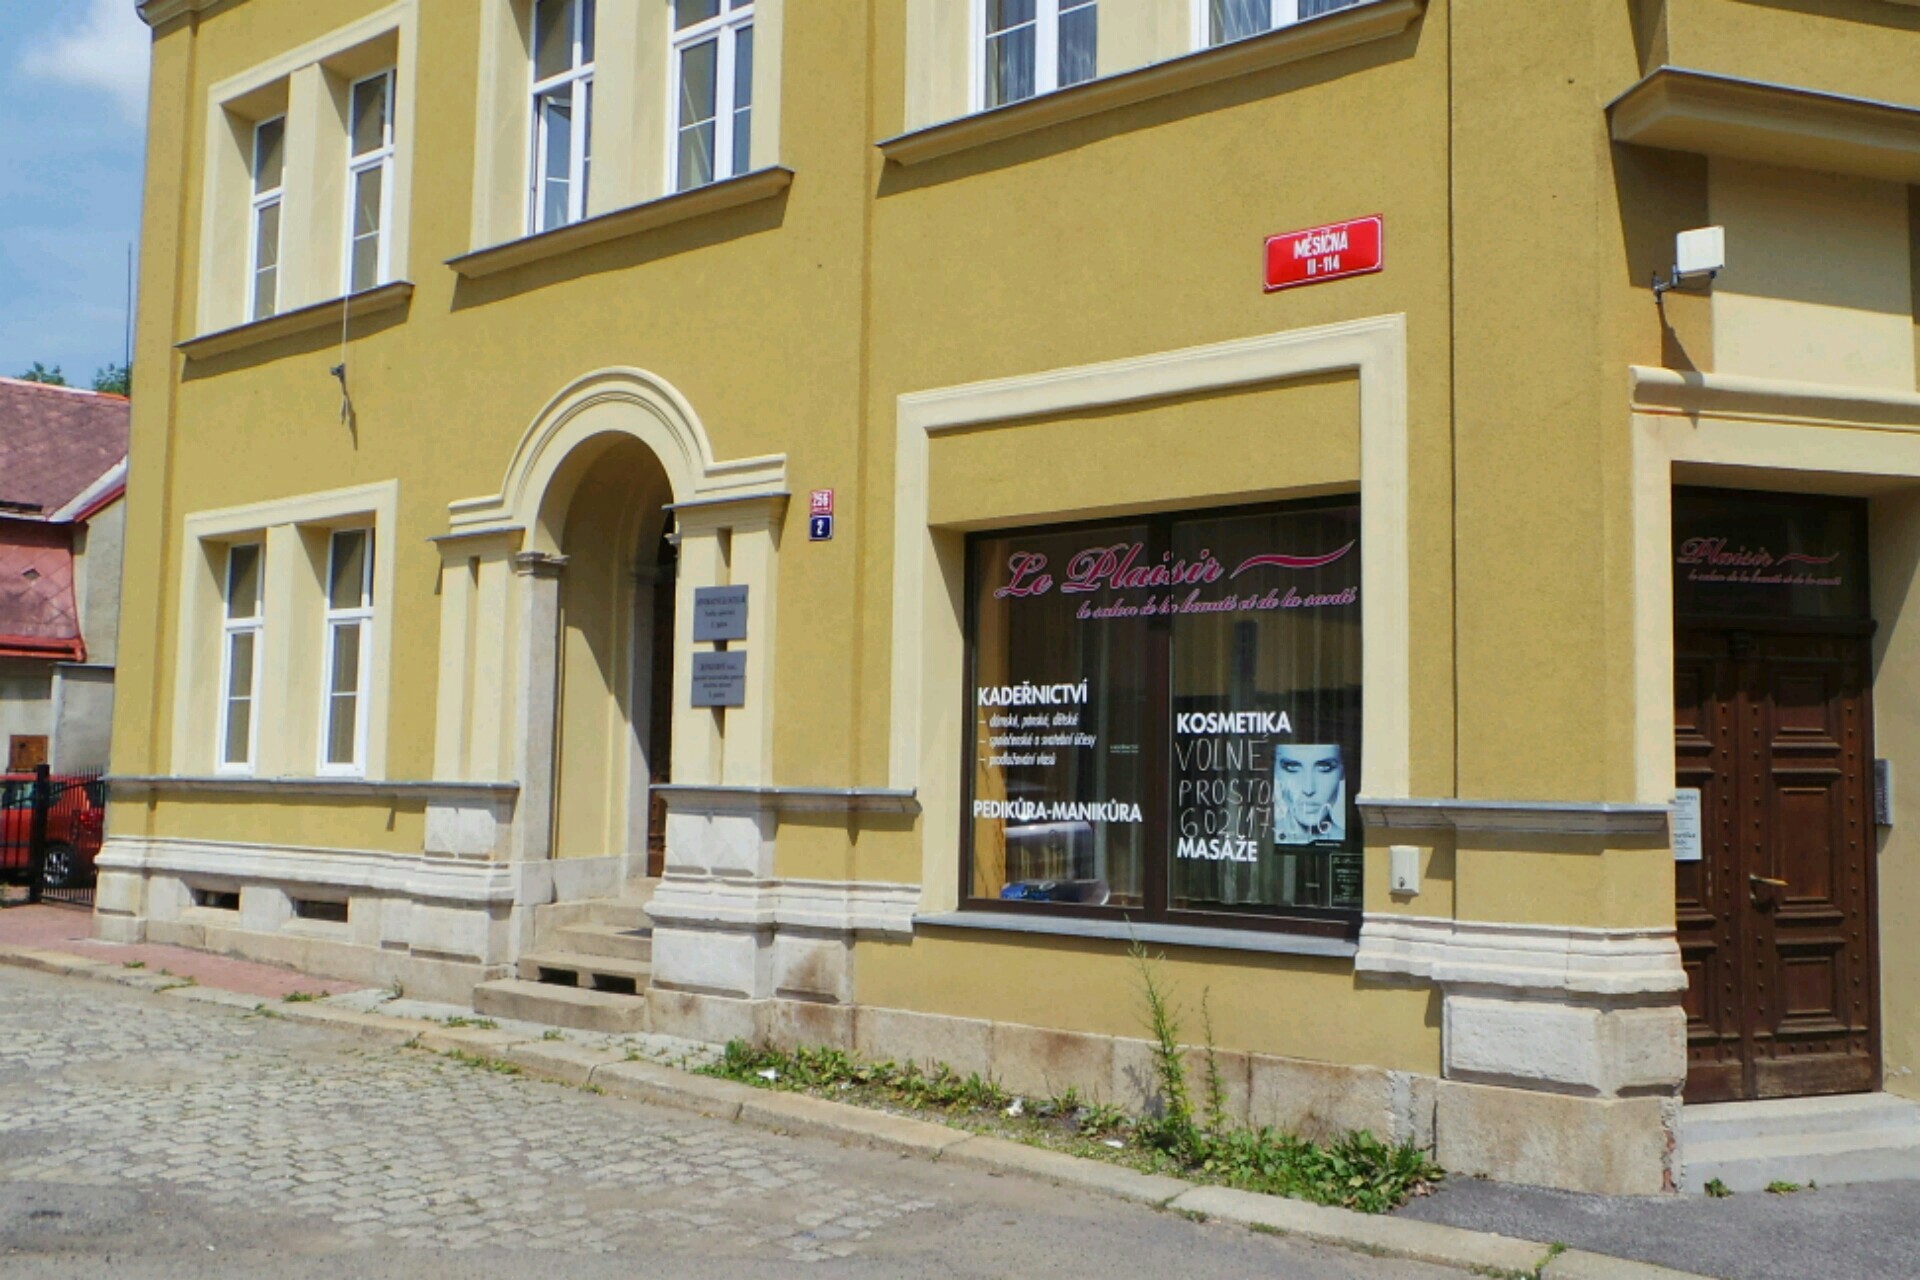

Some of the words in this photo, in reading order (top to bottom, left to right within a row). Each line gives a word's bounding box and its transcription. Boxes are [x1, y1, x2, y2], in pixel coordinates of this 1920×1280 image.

[1293, 228, 1348, 259] MĚSÍČNÁ
[817, 519, 824, 536] 2
[1676, 537, 1774, 567] Plaisir
[994, 552, 1052, 597] Le
[1060, 542, 1224, 591] Plaisir
[978, 678, 1088, 706] KADEŘNICTVÍ
[1176, 711, 1292, 734] KOSMETIKA
[1177, 834, 1258, 862] MASÁŽE
